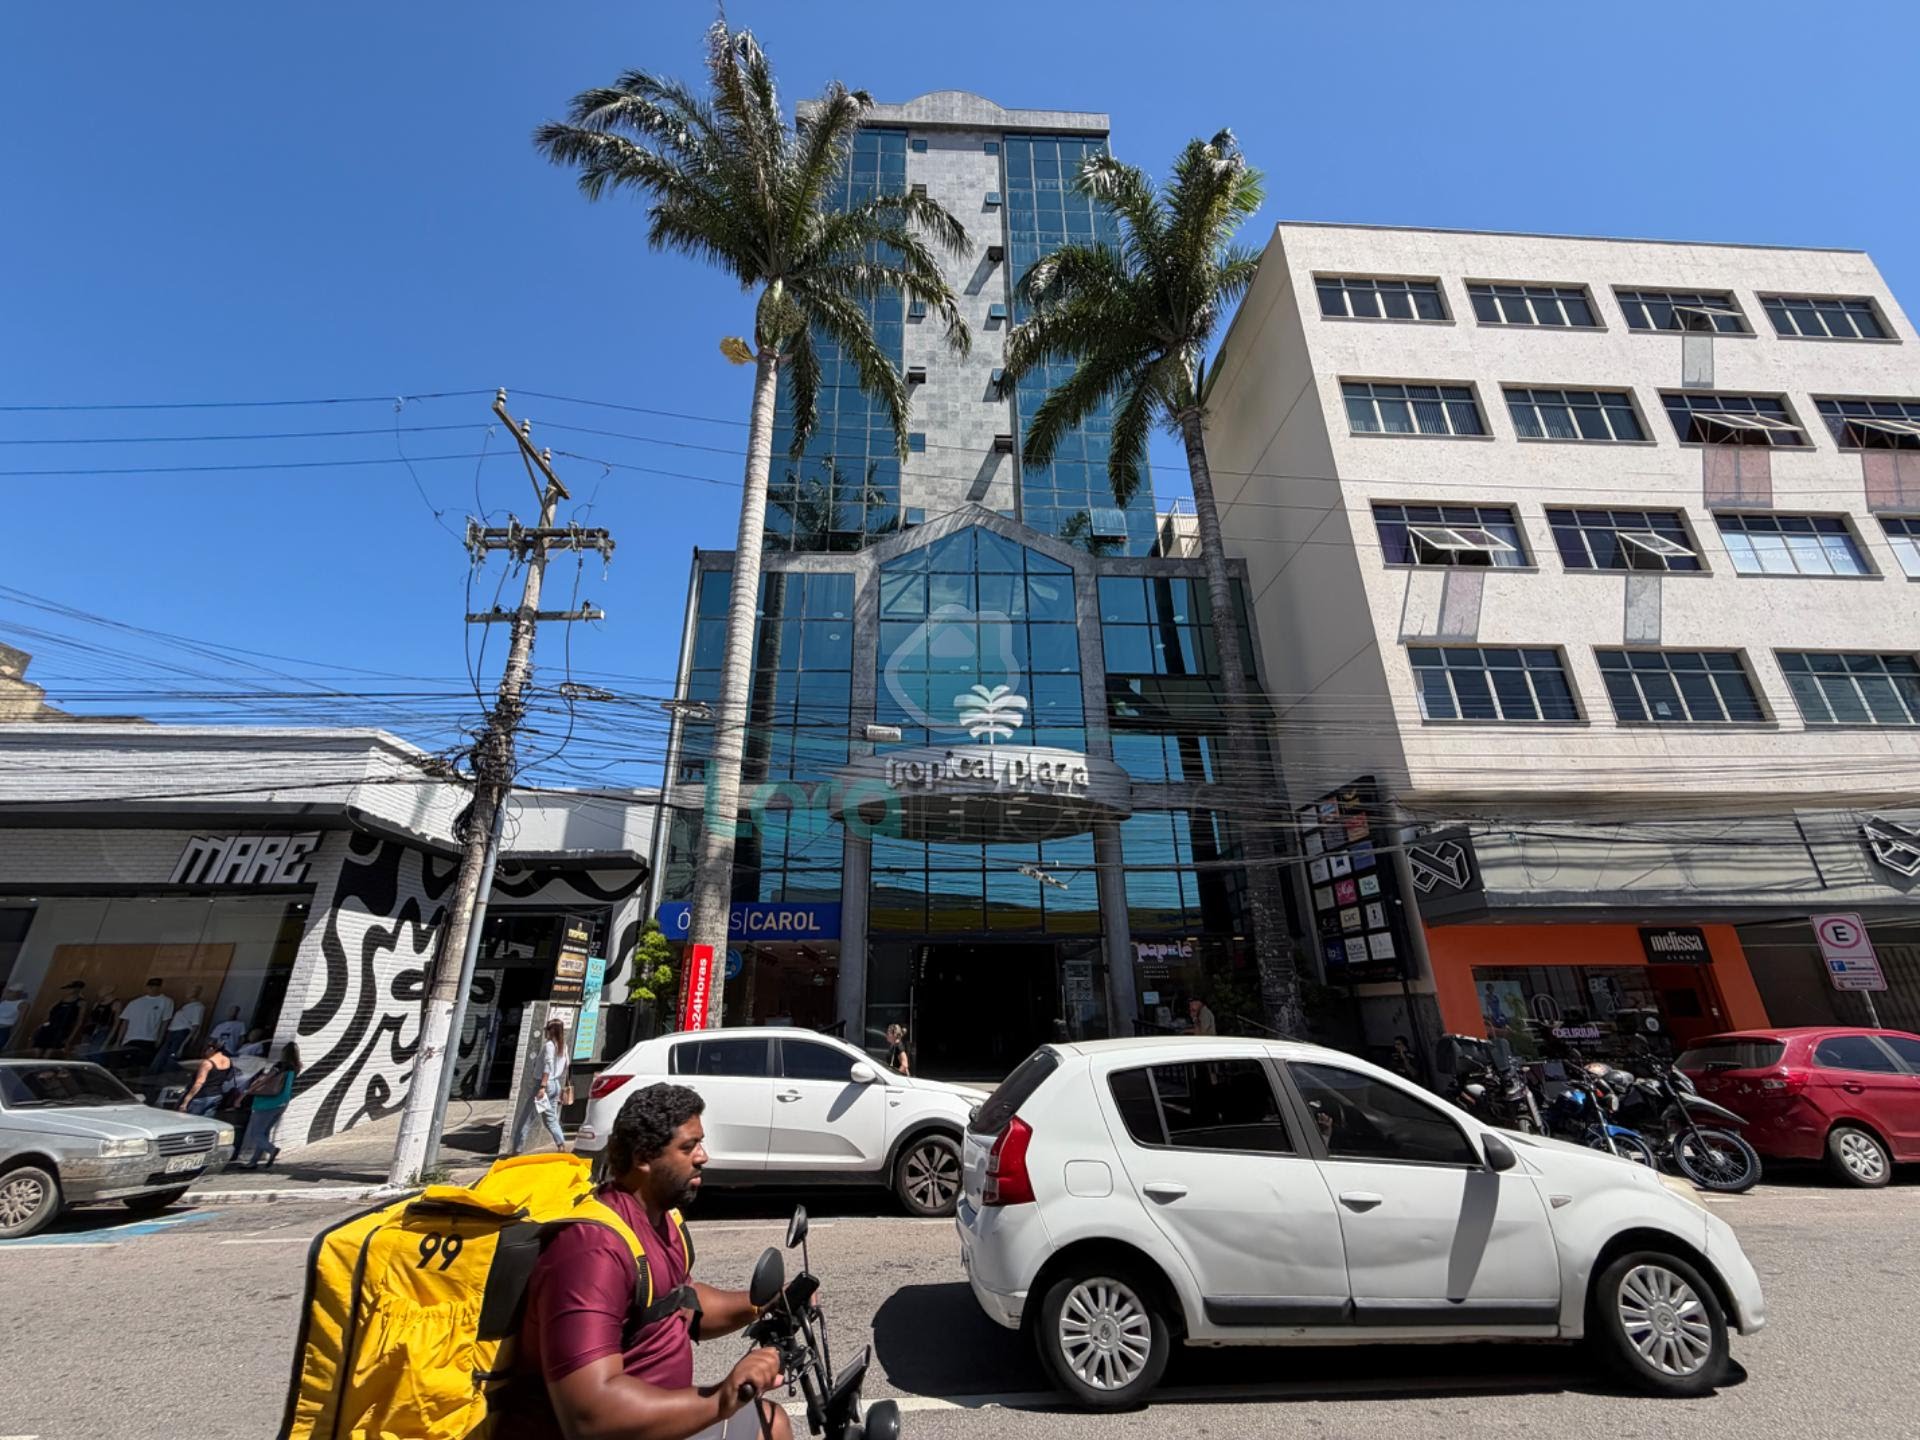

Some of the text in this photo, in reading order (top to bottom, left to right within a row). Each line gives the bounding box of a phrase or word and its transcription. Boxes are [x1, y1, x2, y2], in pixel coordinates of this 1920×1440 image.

[885, 750, 1090, 789] tropical plaza
[749, 911, 821, 931] CAROL
[1650, 931, 1704, 952] melissa
[1832, 925, 1850, 942] E
[692, 958, 708, 1032] o24Horas
[1552, 1026, 1600, 1039] DELIRIUM
[416, 1231, 463, 1271] 99
